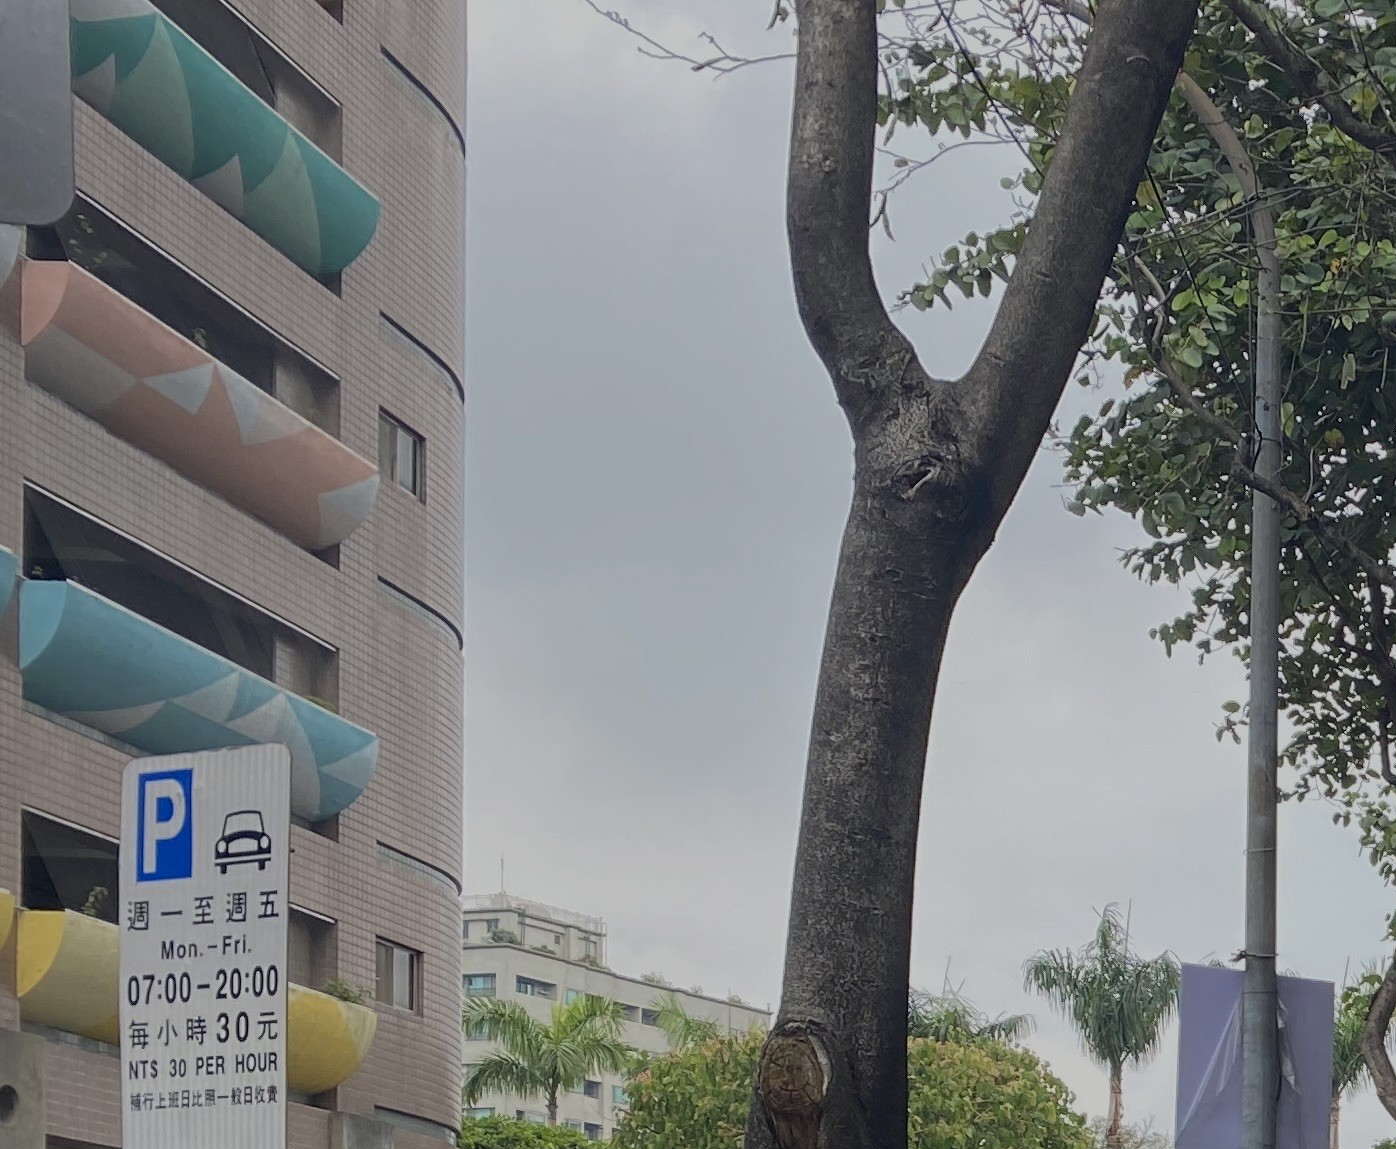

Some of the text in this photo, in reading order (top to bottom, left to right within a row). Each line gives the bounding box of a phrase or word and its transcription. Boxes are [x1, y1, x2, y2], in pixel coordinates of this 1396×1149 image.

[143, 778, 187, 875] P
[127, 890, 279, 932] 週一至週五
[127, 964, 279, 1006] 07:00-20:00
[169, 1058, 187, 1078] 30
[195, 1055, 226, 1076] PER
[235, 1051, 279, 1074] HOUR
